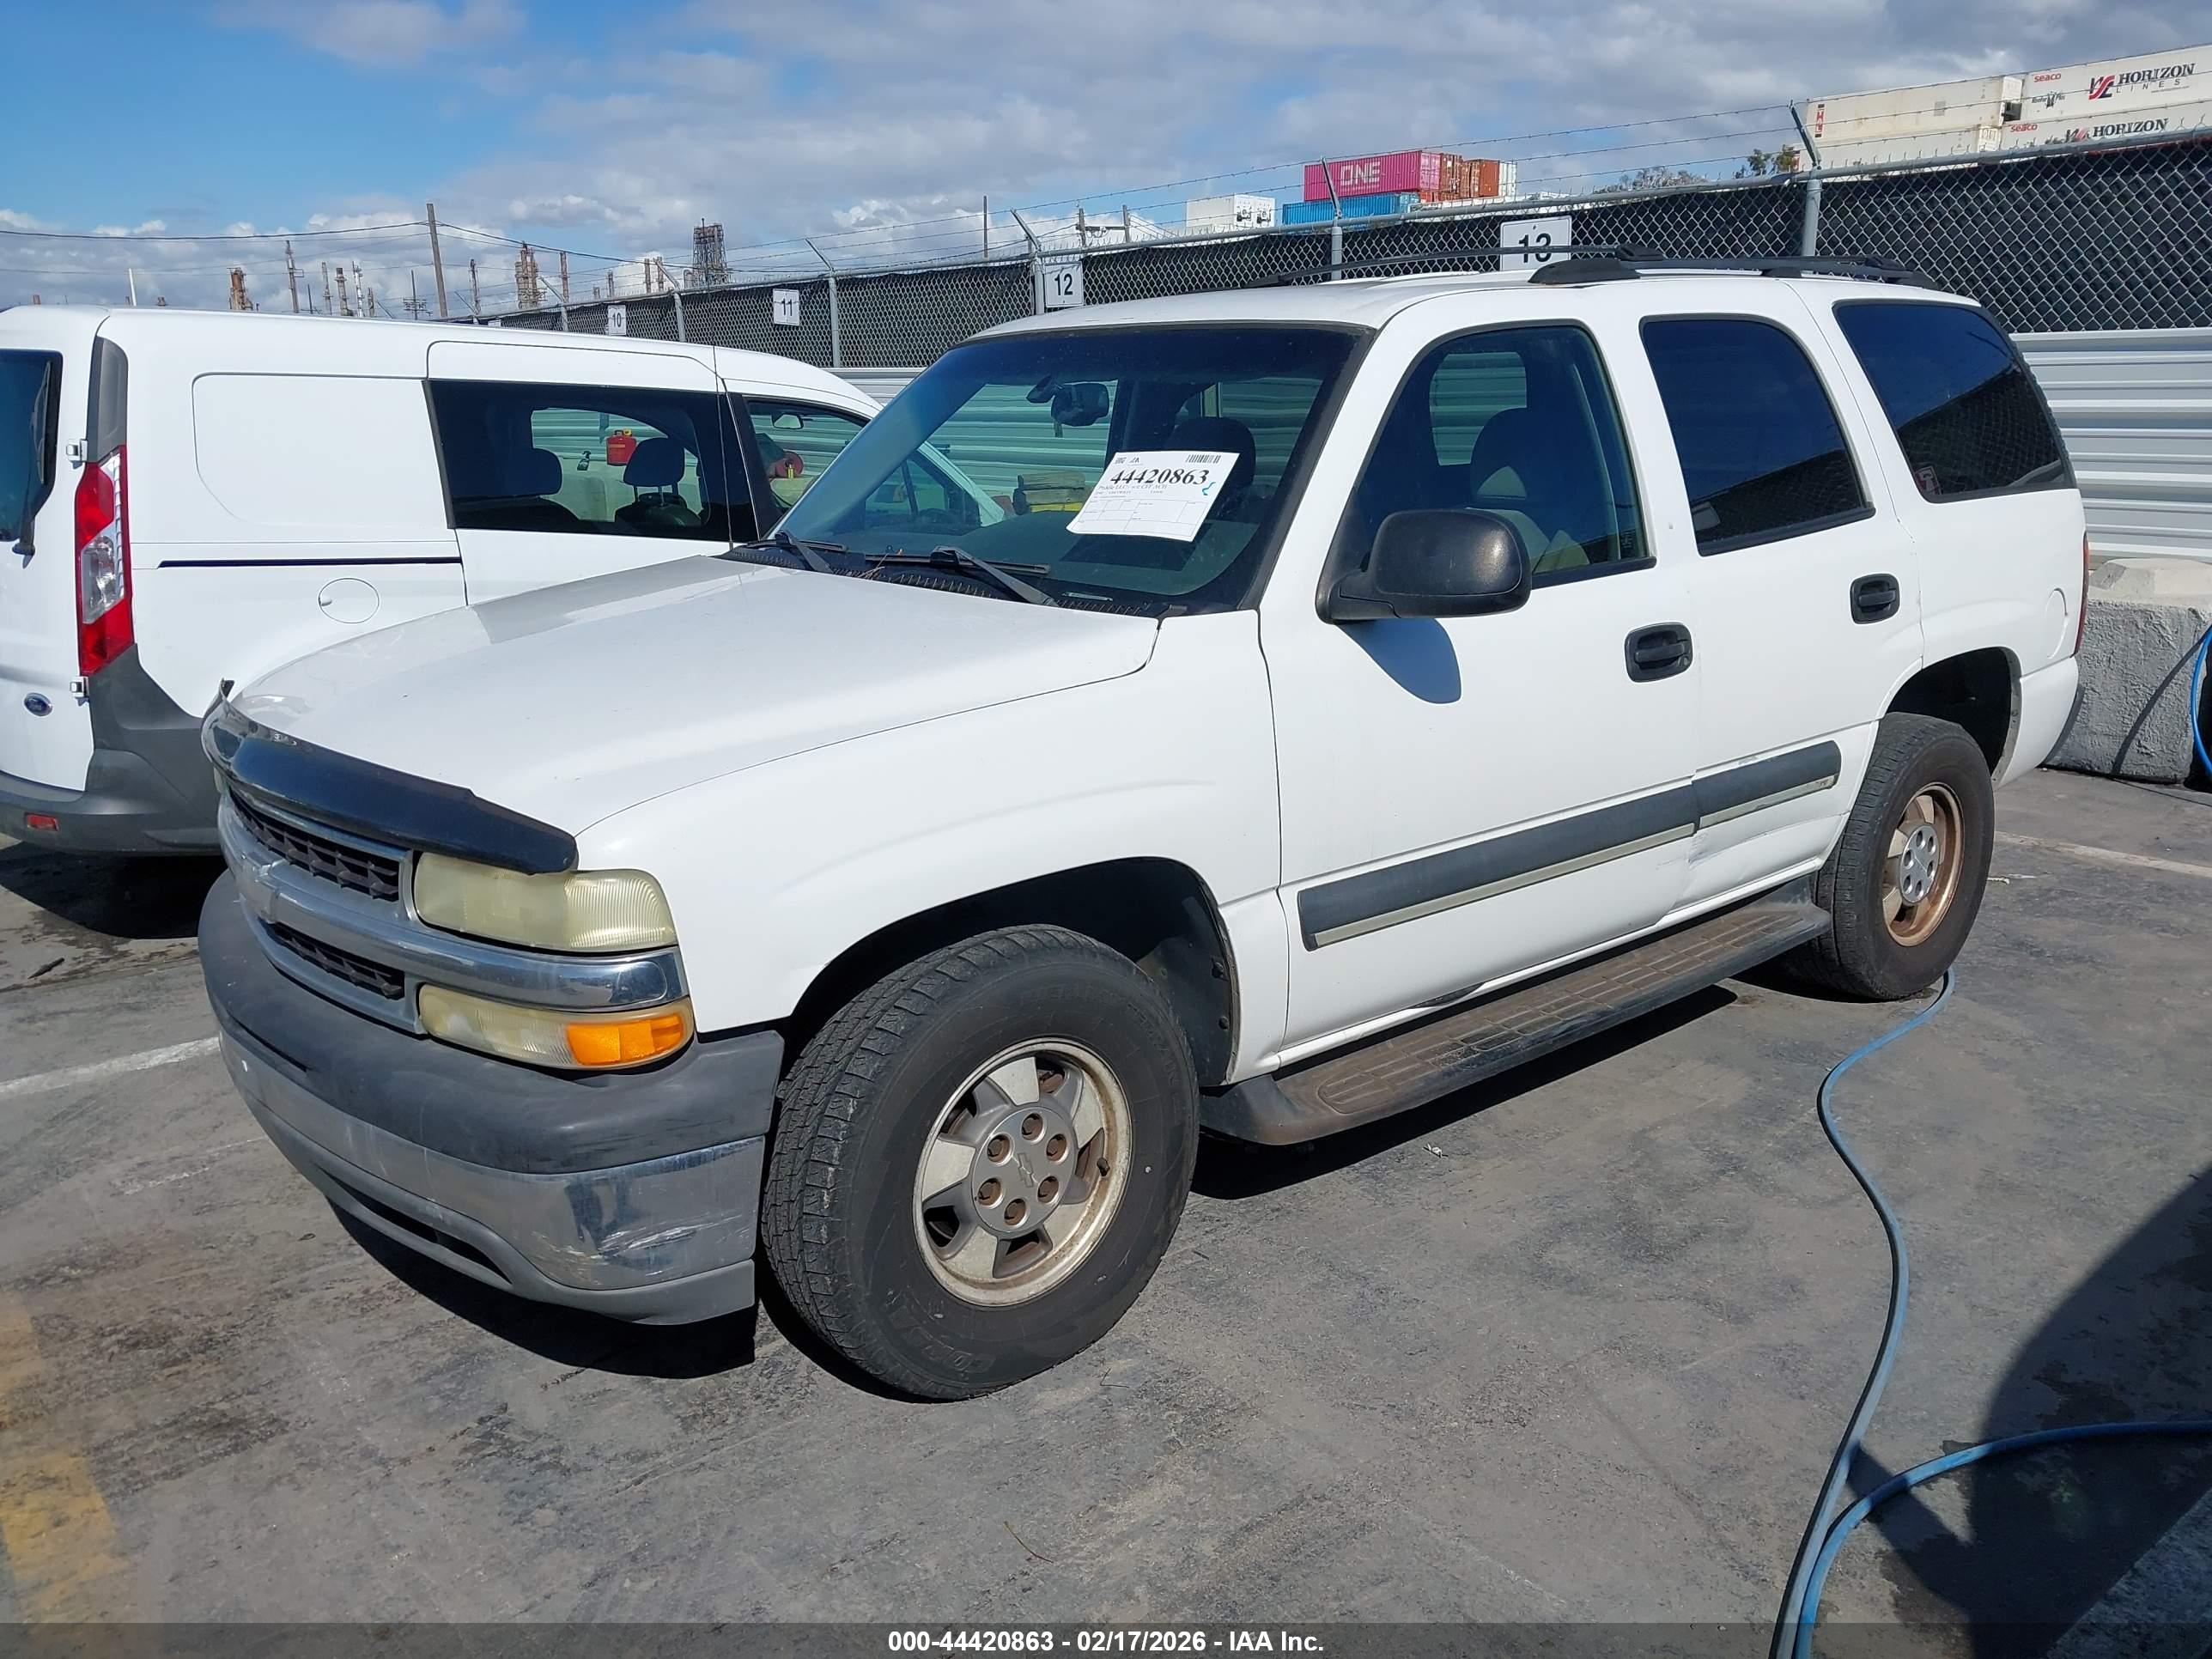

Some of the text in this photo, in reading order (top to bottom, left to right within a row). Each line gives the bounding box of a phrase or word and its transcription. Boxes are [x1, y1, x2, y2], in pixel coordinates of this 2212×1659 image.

[2033, 73, 2062, 83] seaco
[2118, 63, 2196, 84] HORIZON
[2116, 78, 2181, 94] LINES
[2010, 124, 2039, 133] seaco
[2093, 118, 2169, 137] HORIZON
[1340, 161, 1381, 186] ONE
[1518, 233, 1552, 263] 13
[1054, 273, 1073, 296] 12
[781, 298, 793, 317] 11
[612, 312, 622, 328] 10
[1110, 469, 1210, 485] 44420863
